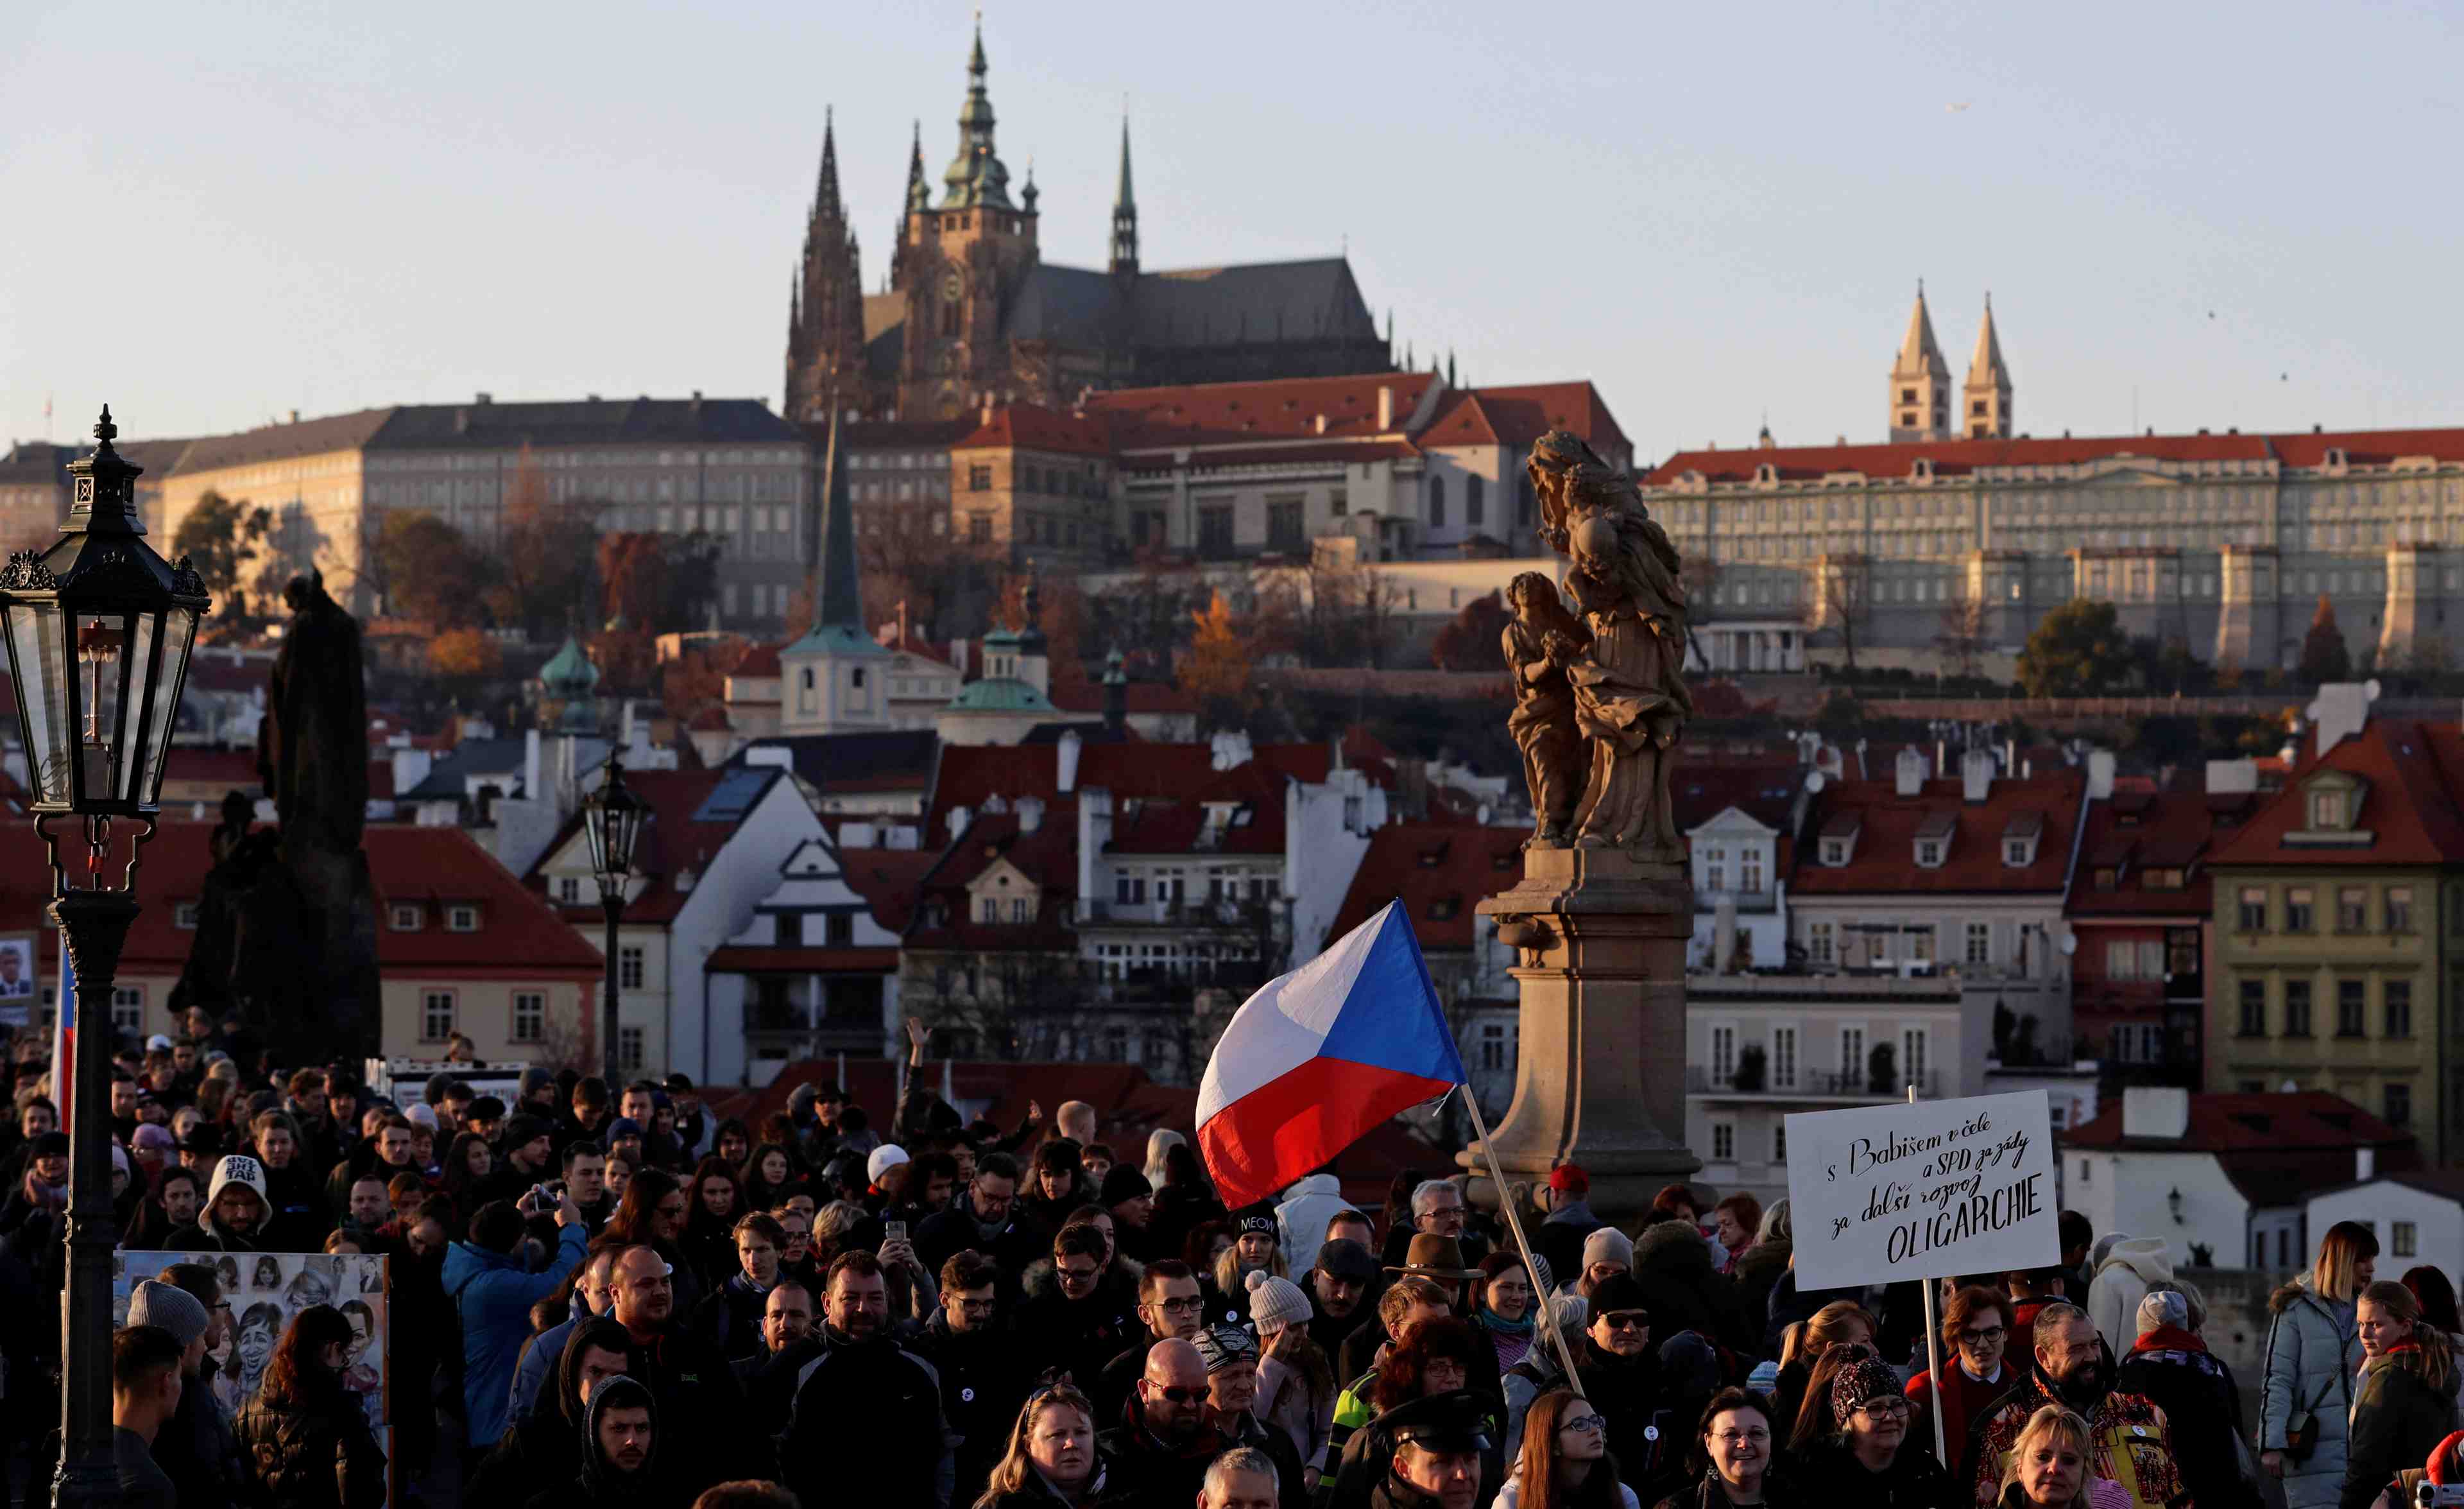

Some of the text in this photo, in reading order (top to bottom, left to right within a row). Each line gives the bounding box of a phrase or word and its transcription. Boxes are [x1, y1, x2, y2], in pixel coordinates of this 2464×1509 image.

[1827, 1112, 1992, 1182] s Babišem v čele
[1923, 1130, 2030, 1178] a SPD za zády
[1241, 1217, 1274, 1232] MEOW
[1830, 1169, 1982, 1240] za další rozvoj
[1887, 1173, 2042, 1264] OLIGARCHIE
